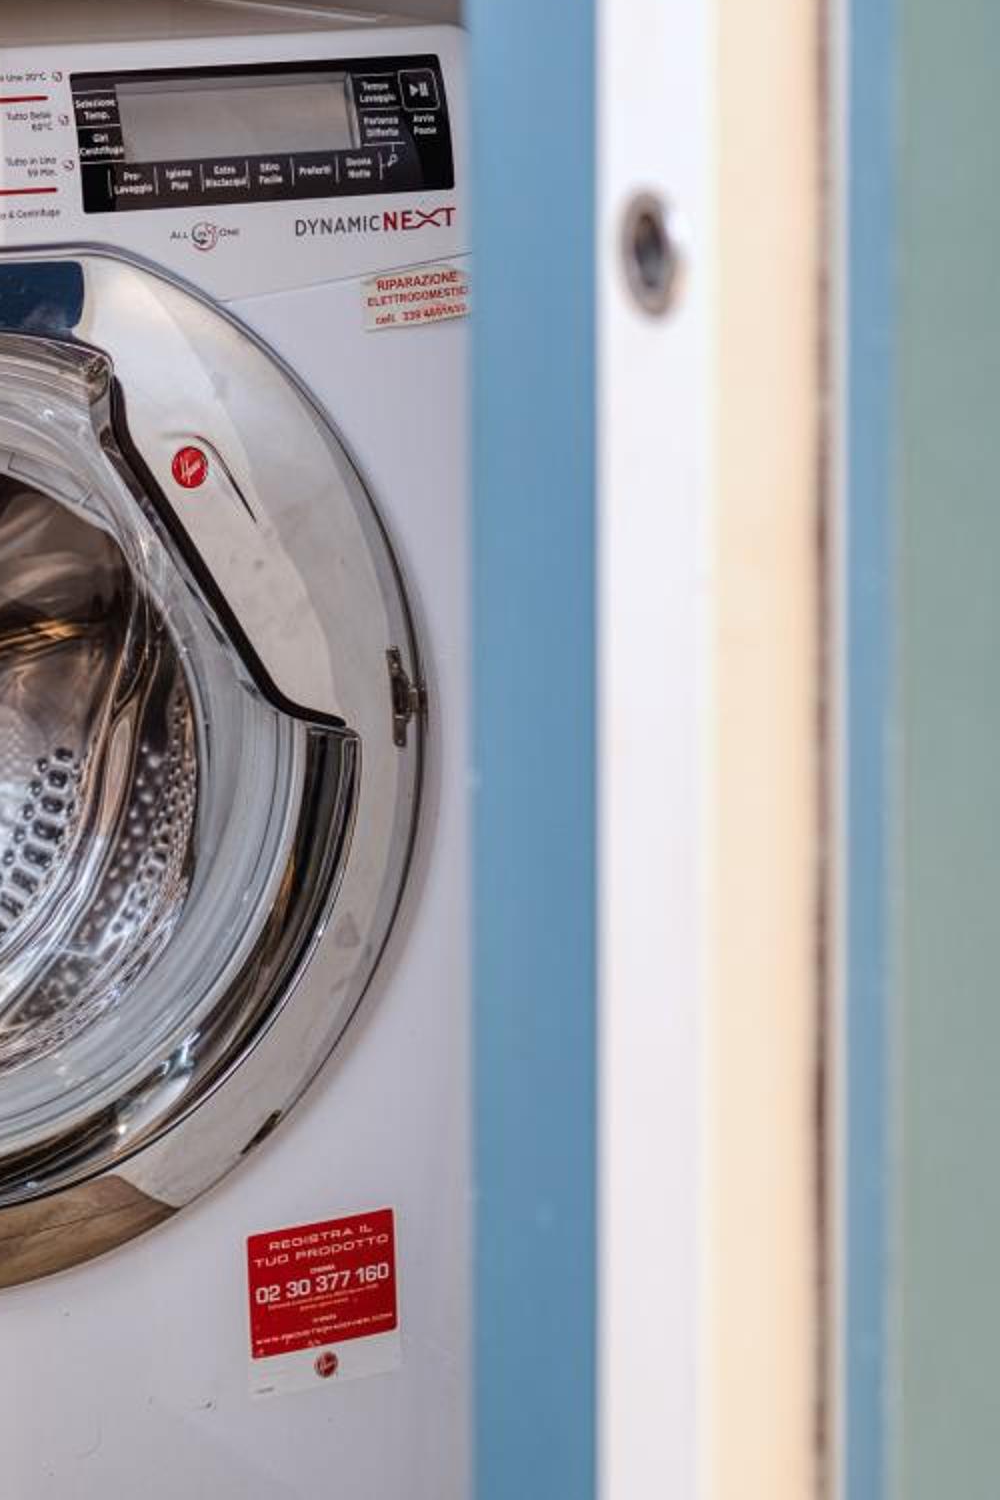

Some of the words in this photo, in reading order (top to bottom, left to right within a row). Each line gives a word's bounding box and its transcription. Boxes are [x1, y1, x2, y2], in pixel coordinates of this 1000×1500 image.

[376, 270, 457, 292] RIPARAZIONE
[253, 1253, 289, 1268] TUO
[295, 1233, 389, 1261] PRODOTTO
[269, 1228, 354, 1251] REGISTRA
[360, 1223, 373, 1233] IL
[255, 1284, 281, 1304] 02
[285, 1279, 311, 1298] 30
[315, 1270, 351, 1293] 377
[355, 1262, 390, 1284] 160
